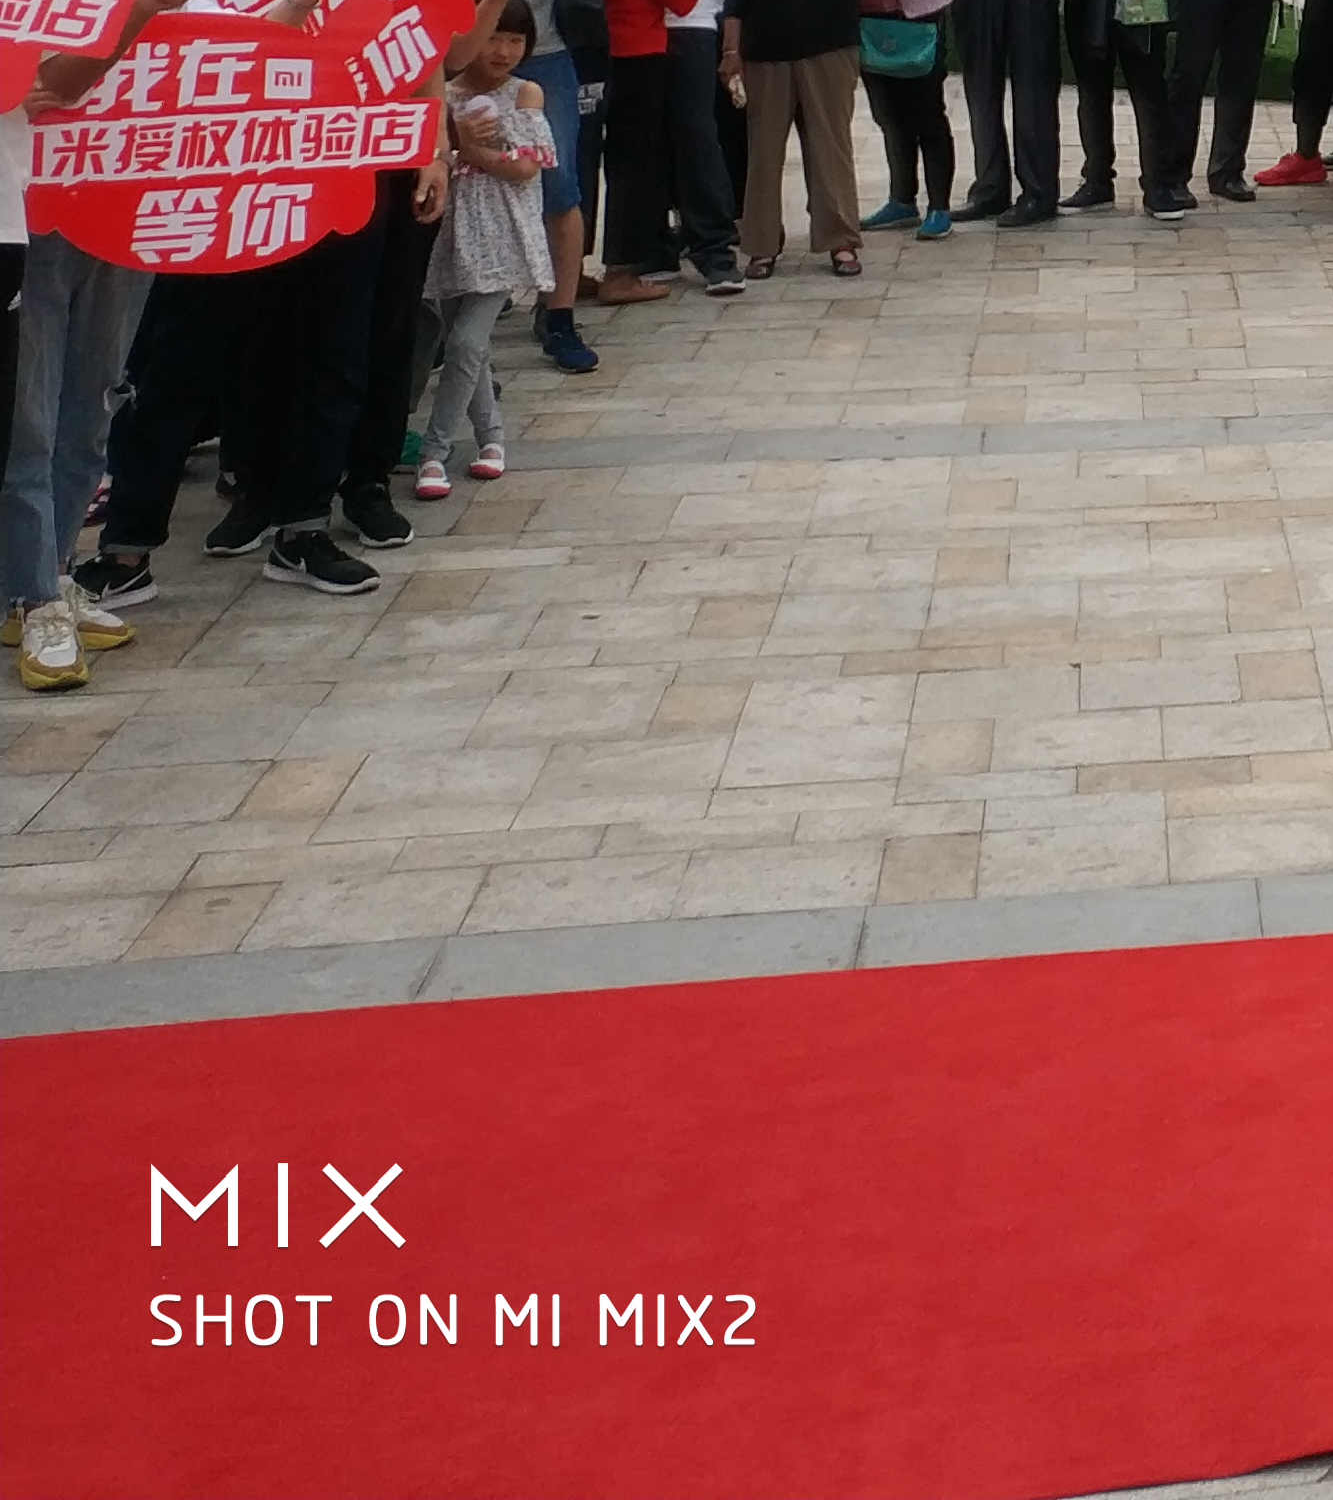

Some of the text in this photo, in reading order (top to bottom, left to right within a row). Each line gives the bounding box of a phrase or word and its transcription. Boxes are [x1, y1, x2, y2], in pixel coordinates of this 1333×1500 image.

[86, 38, 260, 116] 我在
[345, 4, 438, 102] 你
[130, 182, 313, 264] 等你
